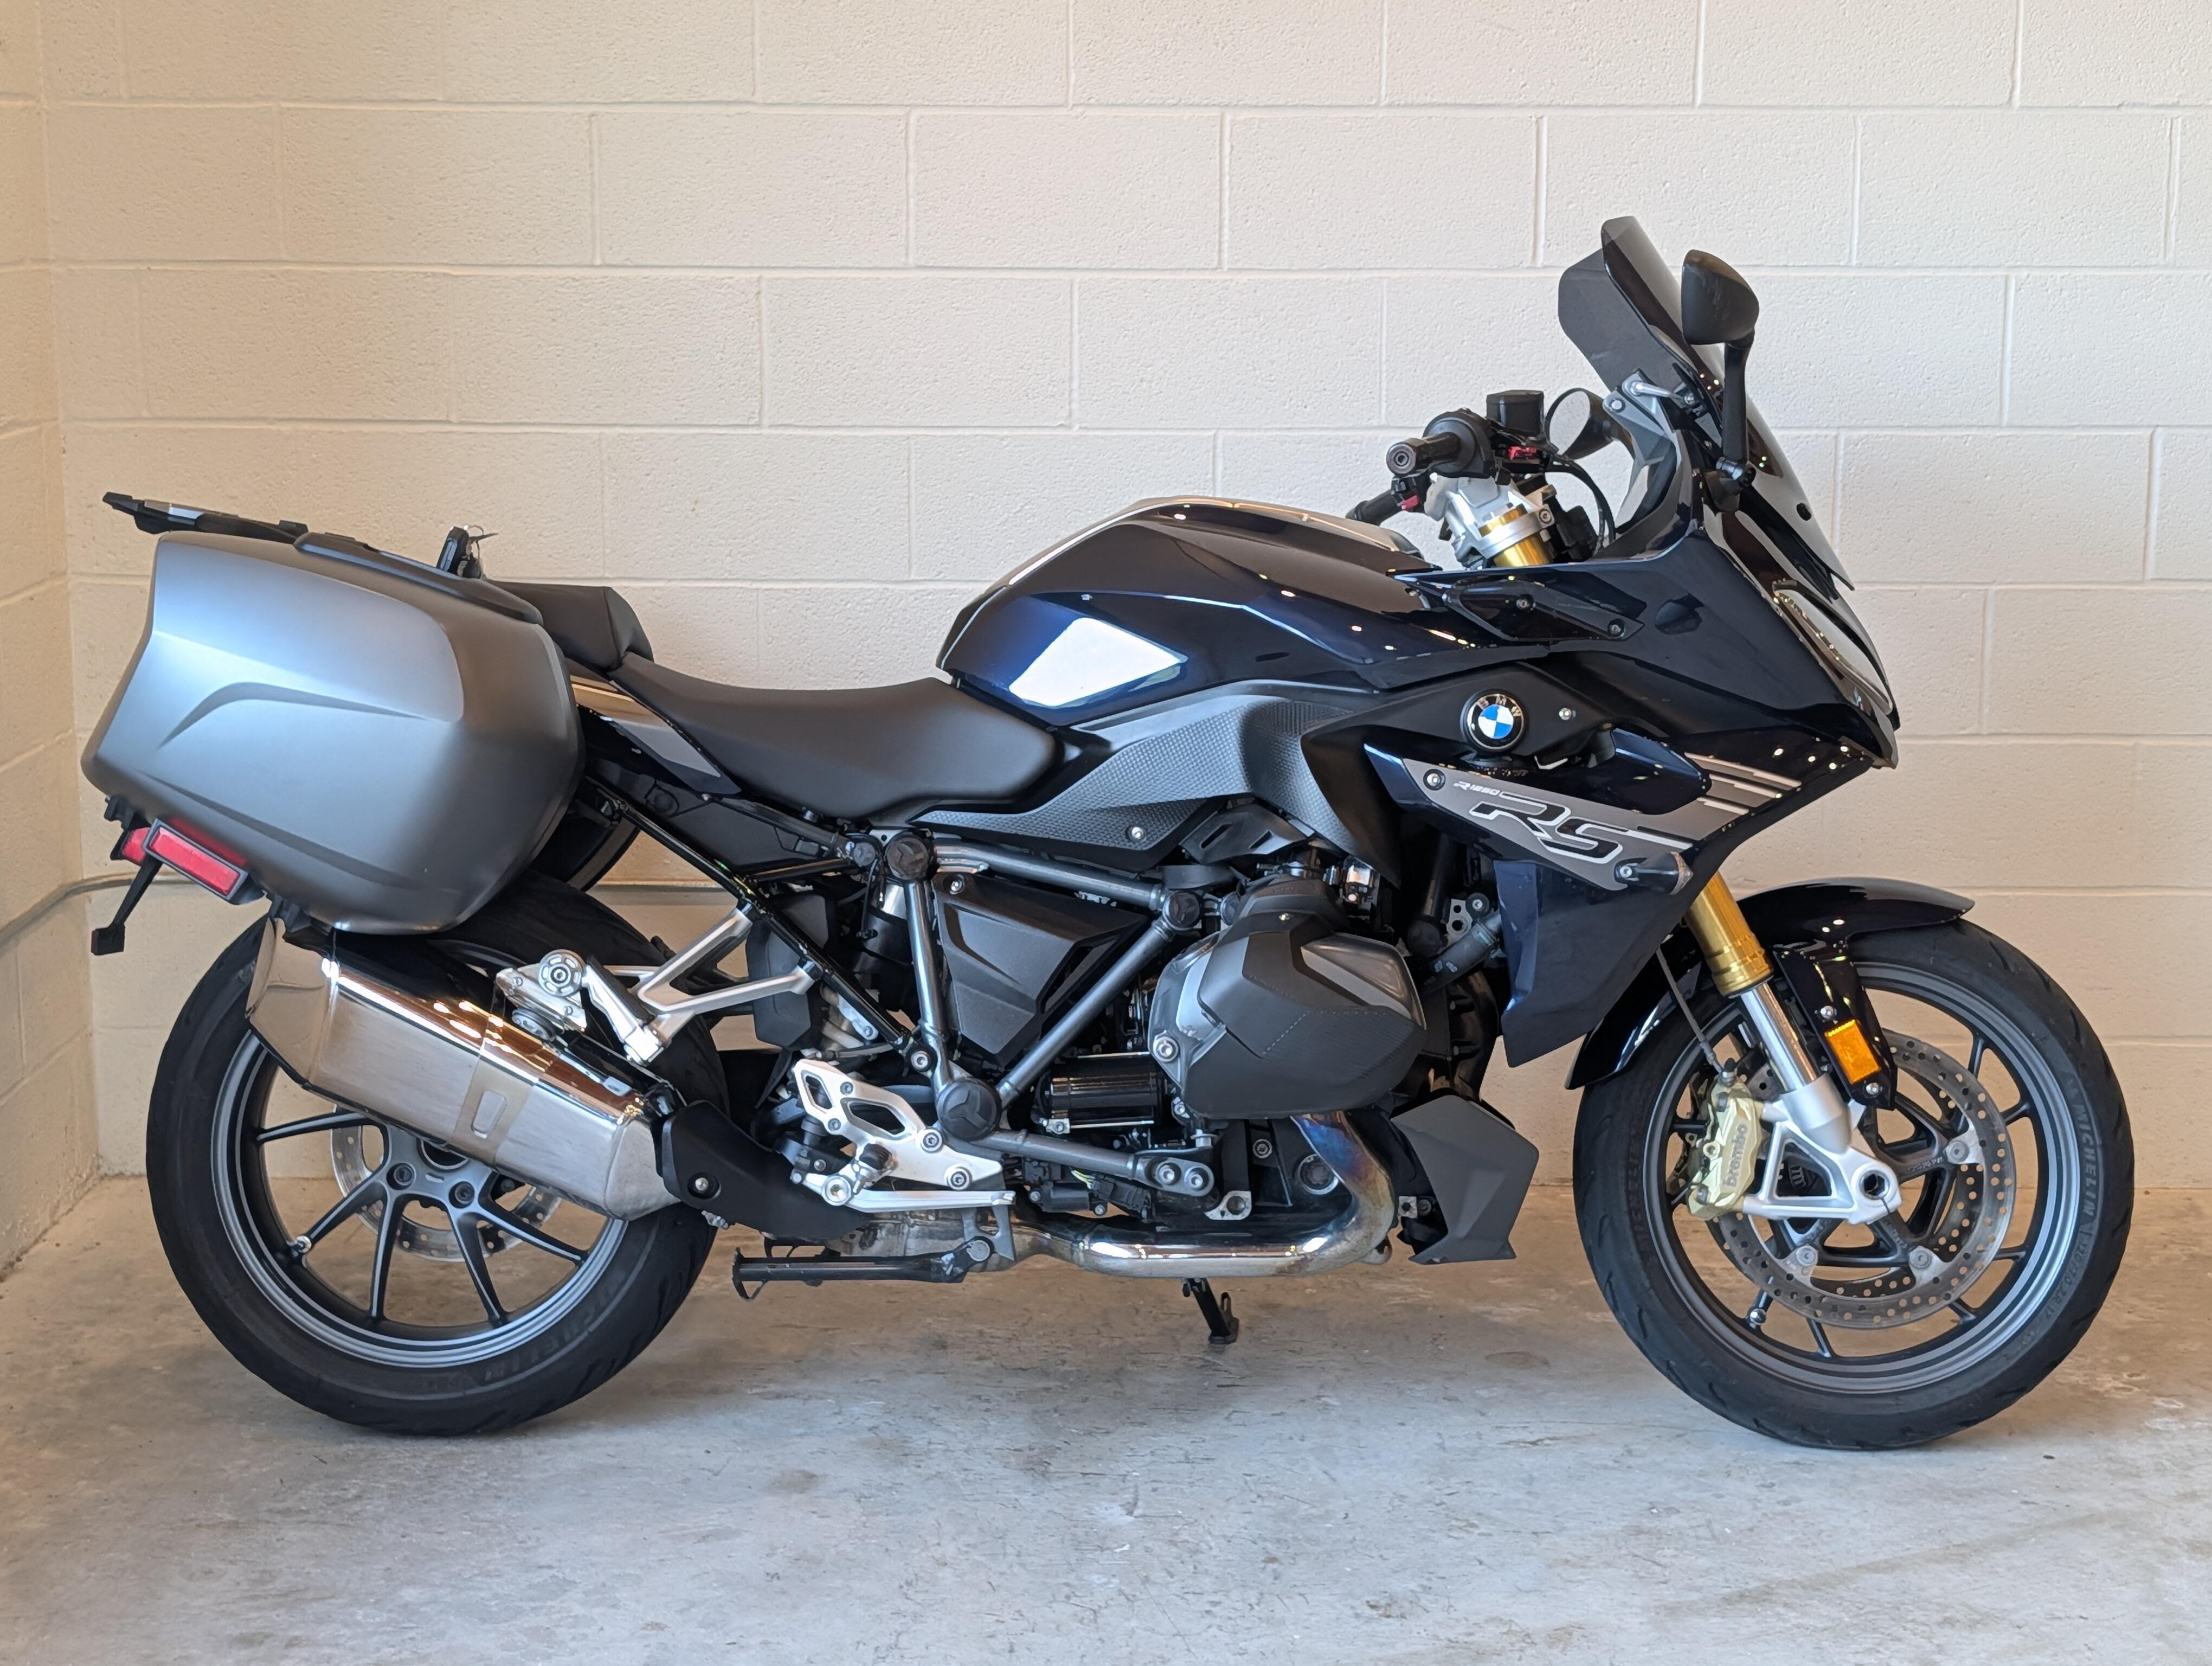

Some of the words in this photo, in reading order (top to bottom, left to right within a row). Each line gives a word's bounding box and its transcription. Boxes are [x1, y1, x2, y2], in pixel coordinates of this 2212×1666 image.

[1476, 694, 1521, 716] BMW
[1469, 790, 1625, 864] RS
[1722, 1124, 1747, 1187] brembo
[2071, 1104, 2097, 1216] MICHELIN
